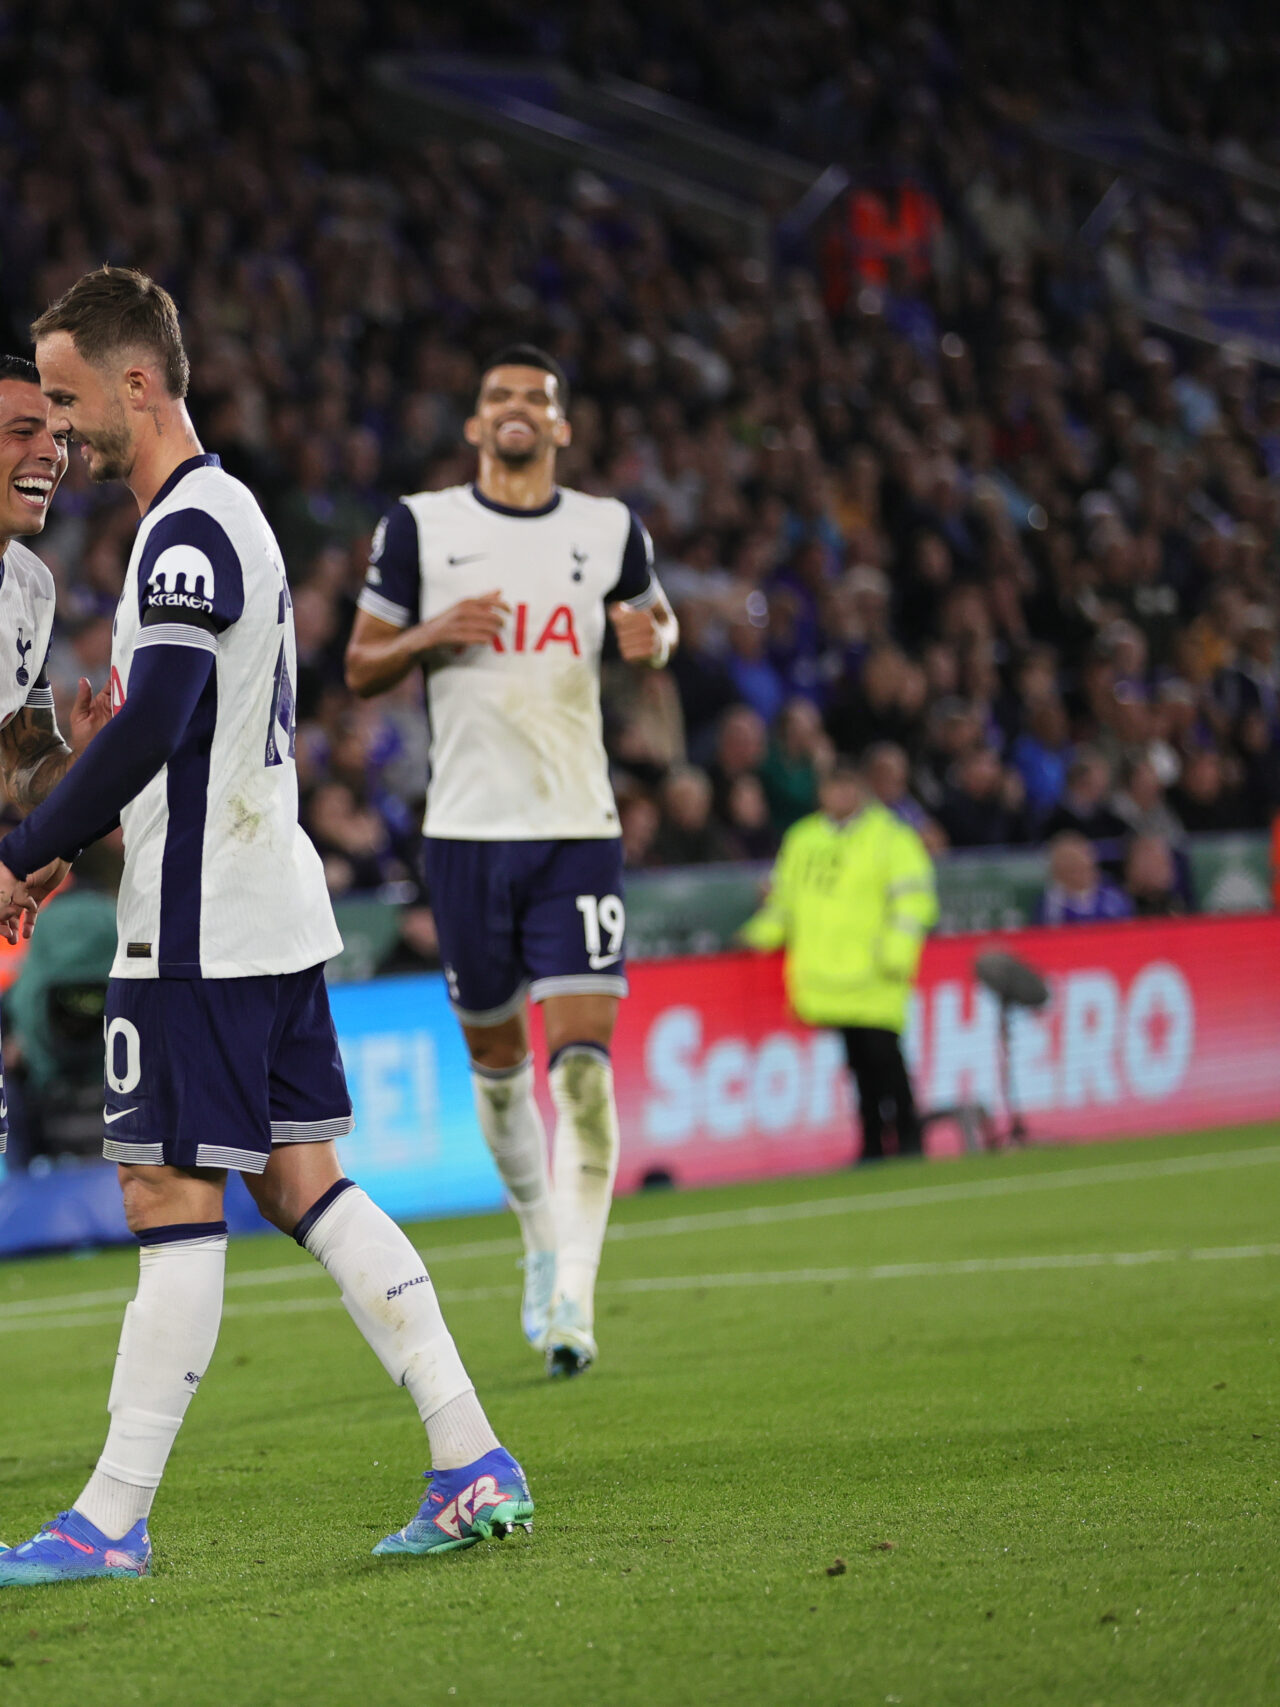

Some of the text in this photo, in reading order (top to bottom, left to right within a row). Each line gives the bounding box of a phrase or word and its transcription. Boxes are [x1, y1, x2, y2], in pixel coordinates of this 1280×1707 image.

[148, 593, 213, 614] kraken
[453, 604, 580, 657] IA
[575, 894, 625, 954] 19
[104, 1015, 141, 1094] 0
